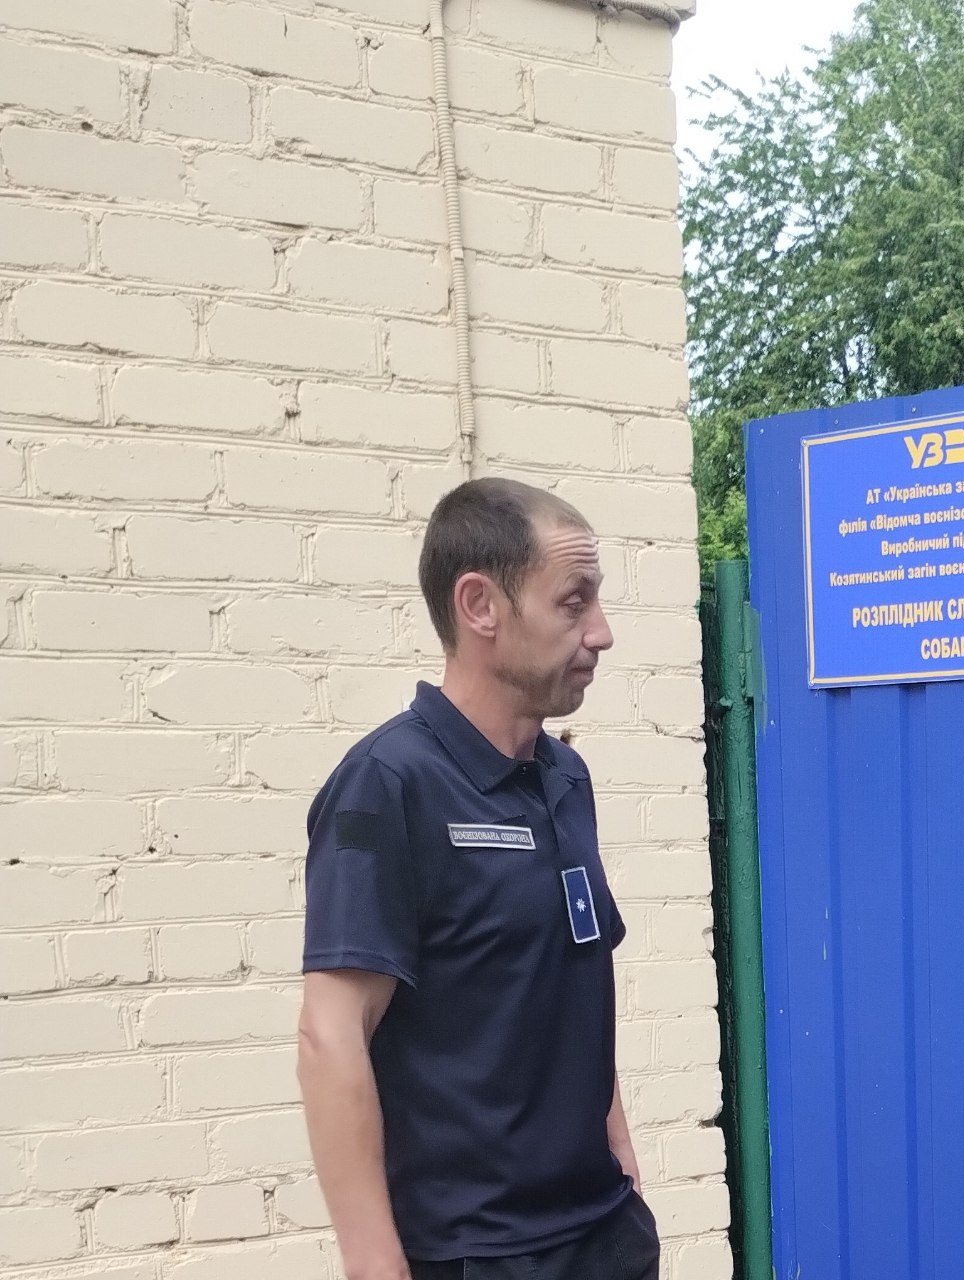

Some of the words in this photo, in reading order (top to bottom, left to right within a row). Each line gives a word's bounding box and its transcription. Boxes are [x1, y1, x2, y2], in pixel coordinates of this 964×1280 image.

[866, 488, 881, 505] АТ
[884, 483, 952, 503] «Українська
[838, 517, 868, 537] філія
[870, 513, 921, 531] «Відомча
[881, 534, 949, 557] Виробничий
[830, 566, 904, 587] Козятинський
[908, 563, 936, 580] загін
[853, 600, 944, 628] РОЗПЛІДНИК
